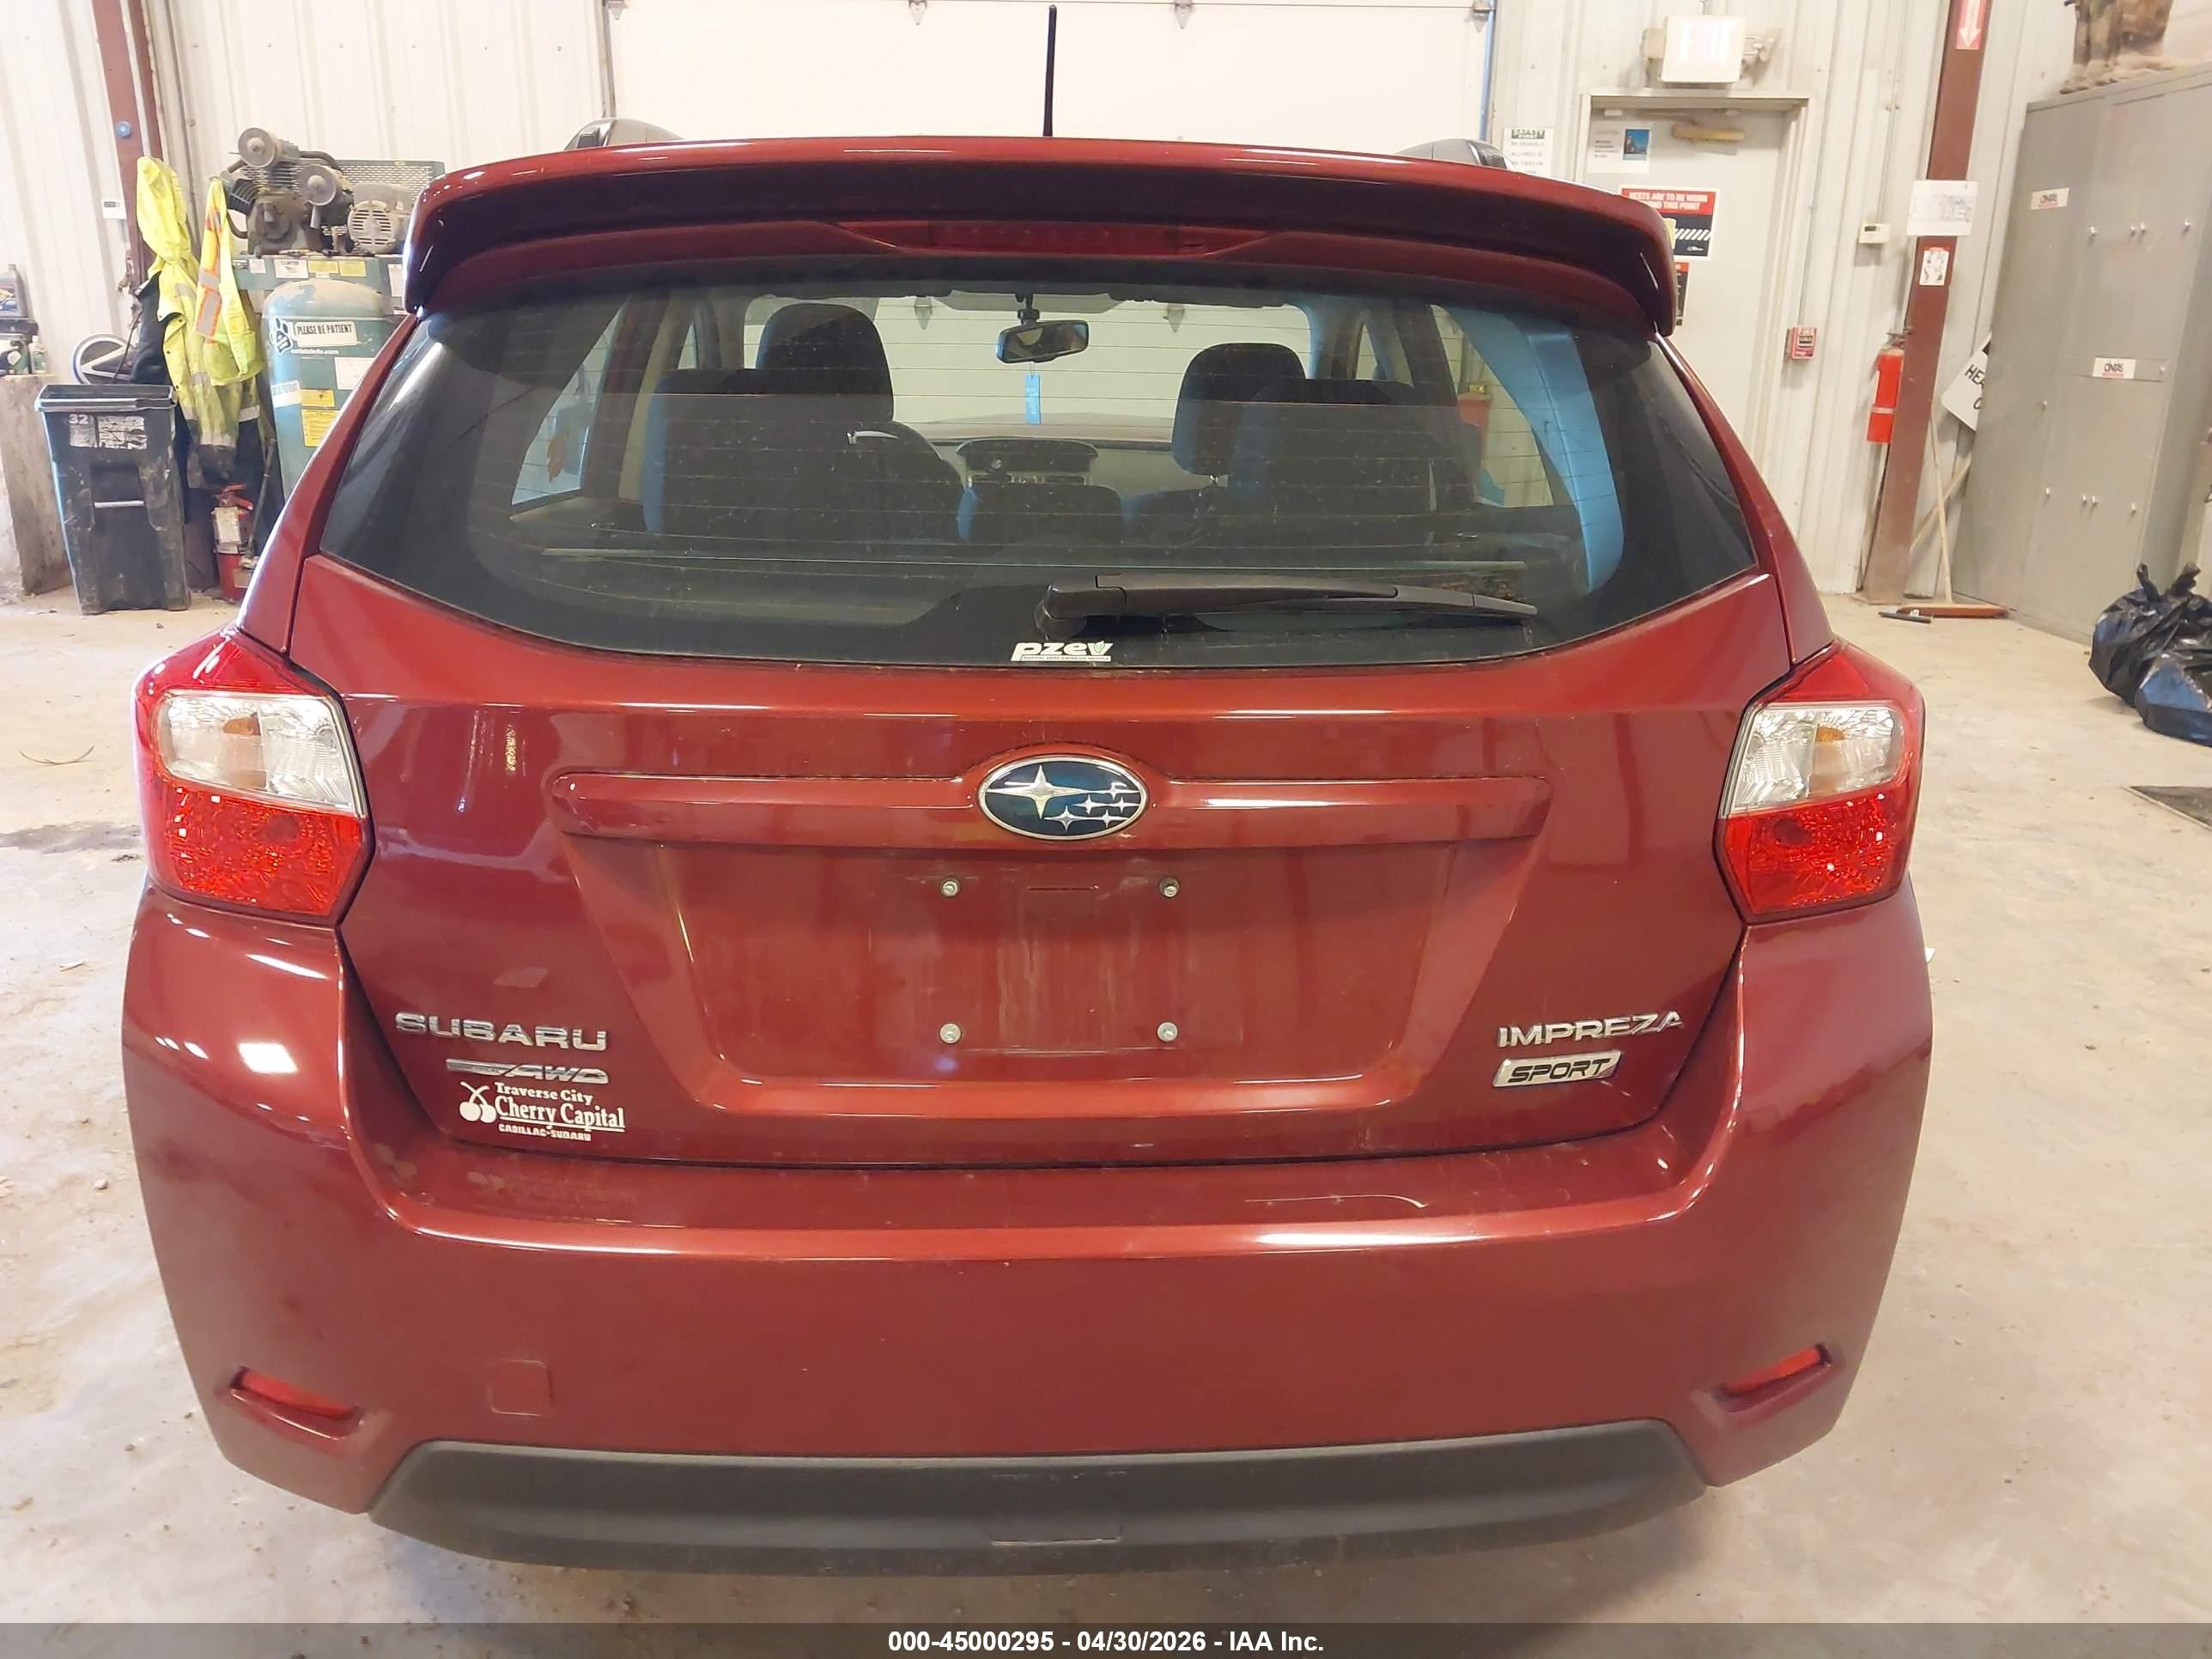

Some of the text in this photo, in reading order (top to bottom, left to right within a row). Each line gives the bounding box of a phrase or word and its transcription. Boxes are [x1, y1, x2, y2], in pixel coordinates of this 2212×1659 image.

[297, 324, 353, 335] PLEASE BE PATIENT
[69, 413, 88, 424] 32
[1011, 641, 1114, 662] pzev
[395, 1012, 607, 1052] SUBARU
[1498, 1010, 1685, 1048] IMPREZA
[504, 1064, 609, 1085] AWD
[1508, 1057, 1612, 1084] SPORT
[495, 1082, 594, 1106] Traverse City
[495, 1096, 626, 1131] Cherry Capital
